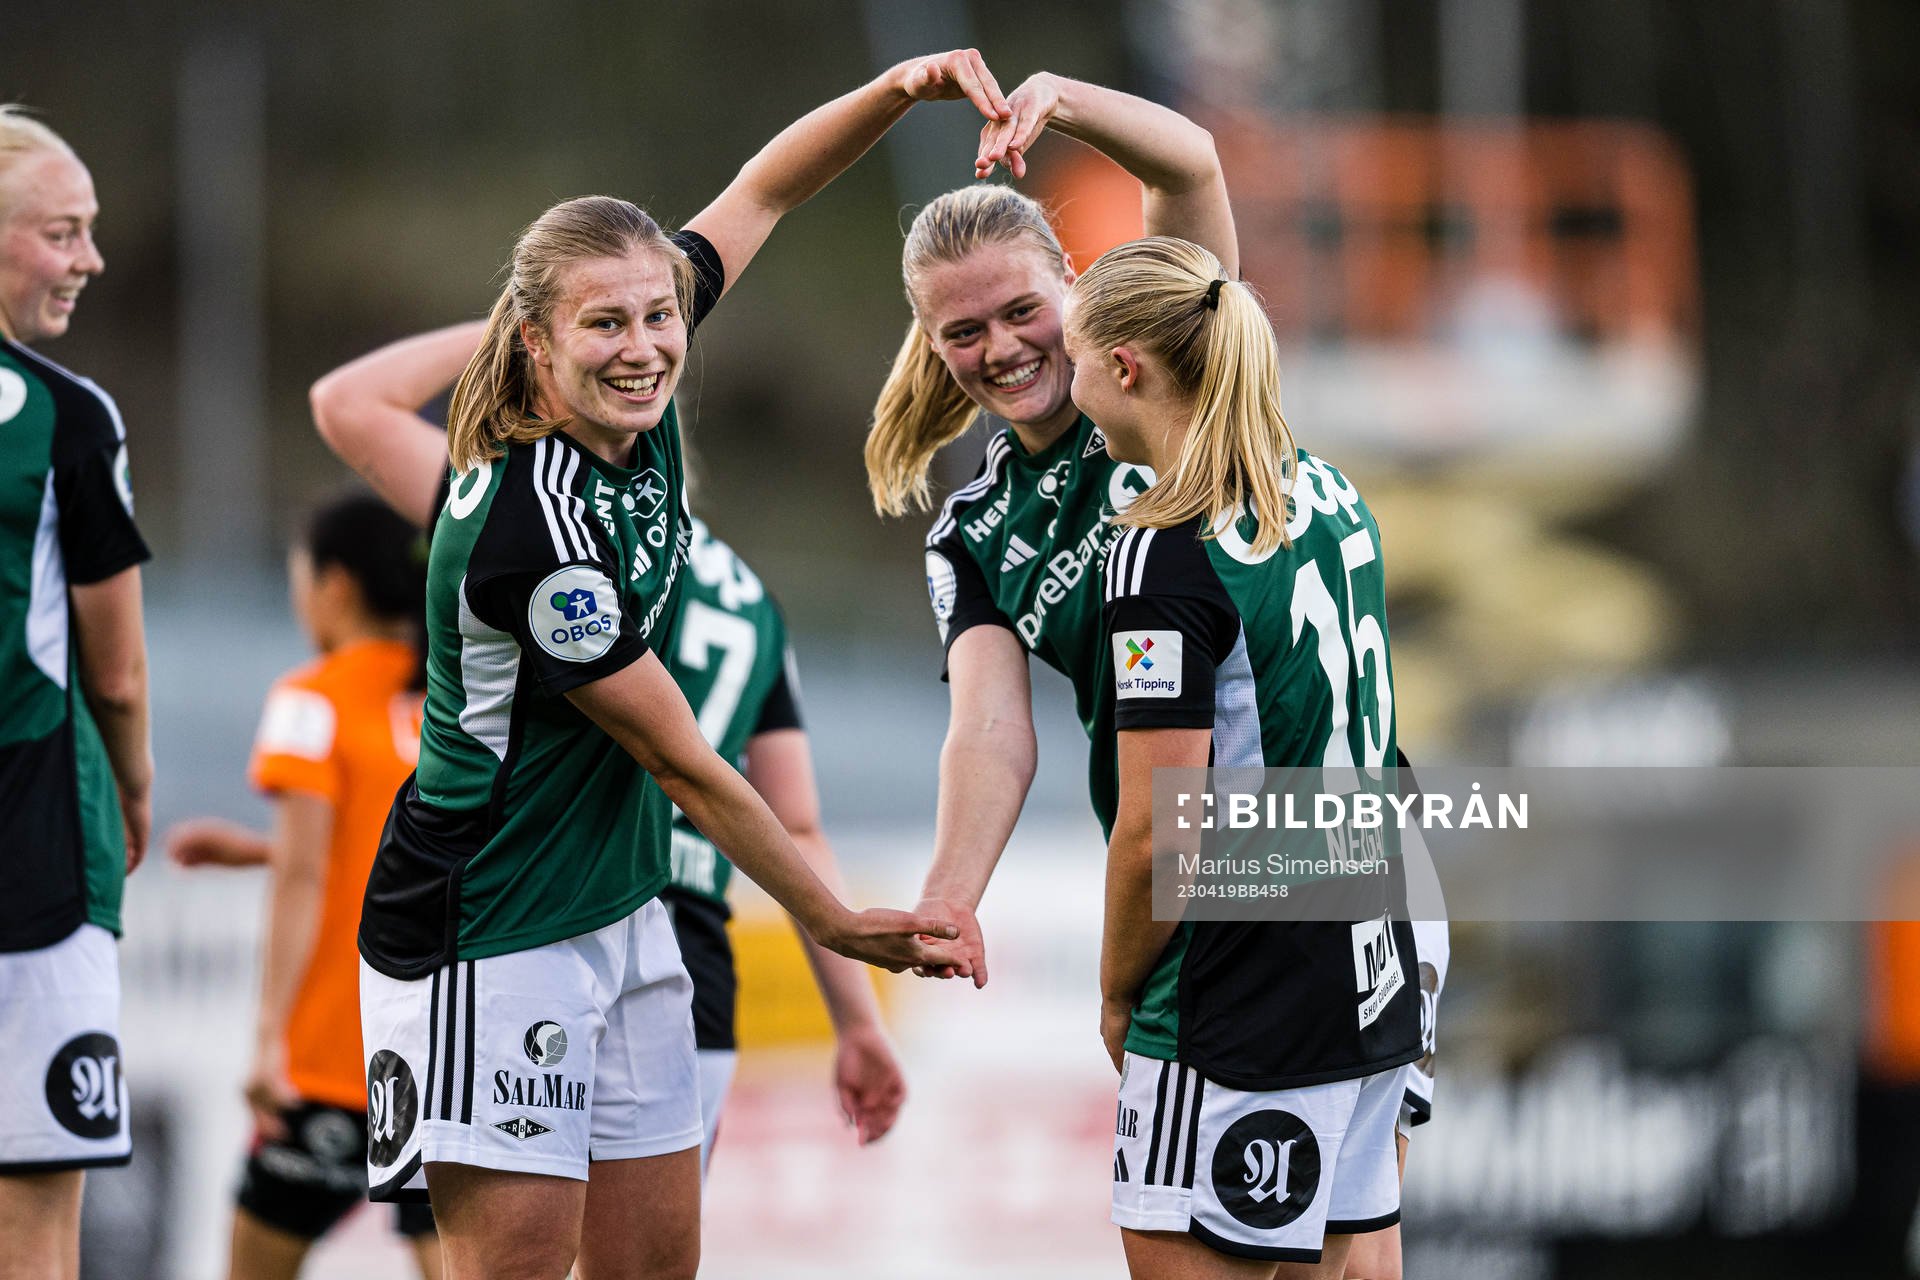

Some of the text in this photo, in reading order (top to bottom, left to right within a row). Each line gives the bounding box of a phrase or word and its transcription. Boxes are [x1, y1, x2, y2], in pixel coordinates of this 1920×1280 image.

[963, 488, 1012, 544] HEN
[551, 613, 612, 644] OBOS
[679, 597, 757, 751] 7
[1134, 677, 1176, 692] Tipping
[1289, 527, 1391, 794] 15
